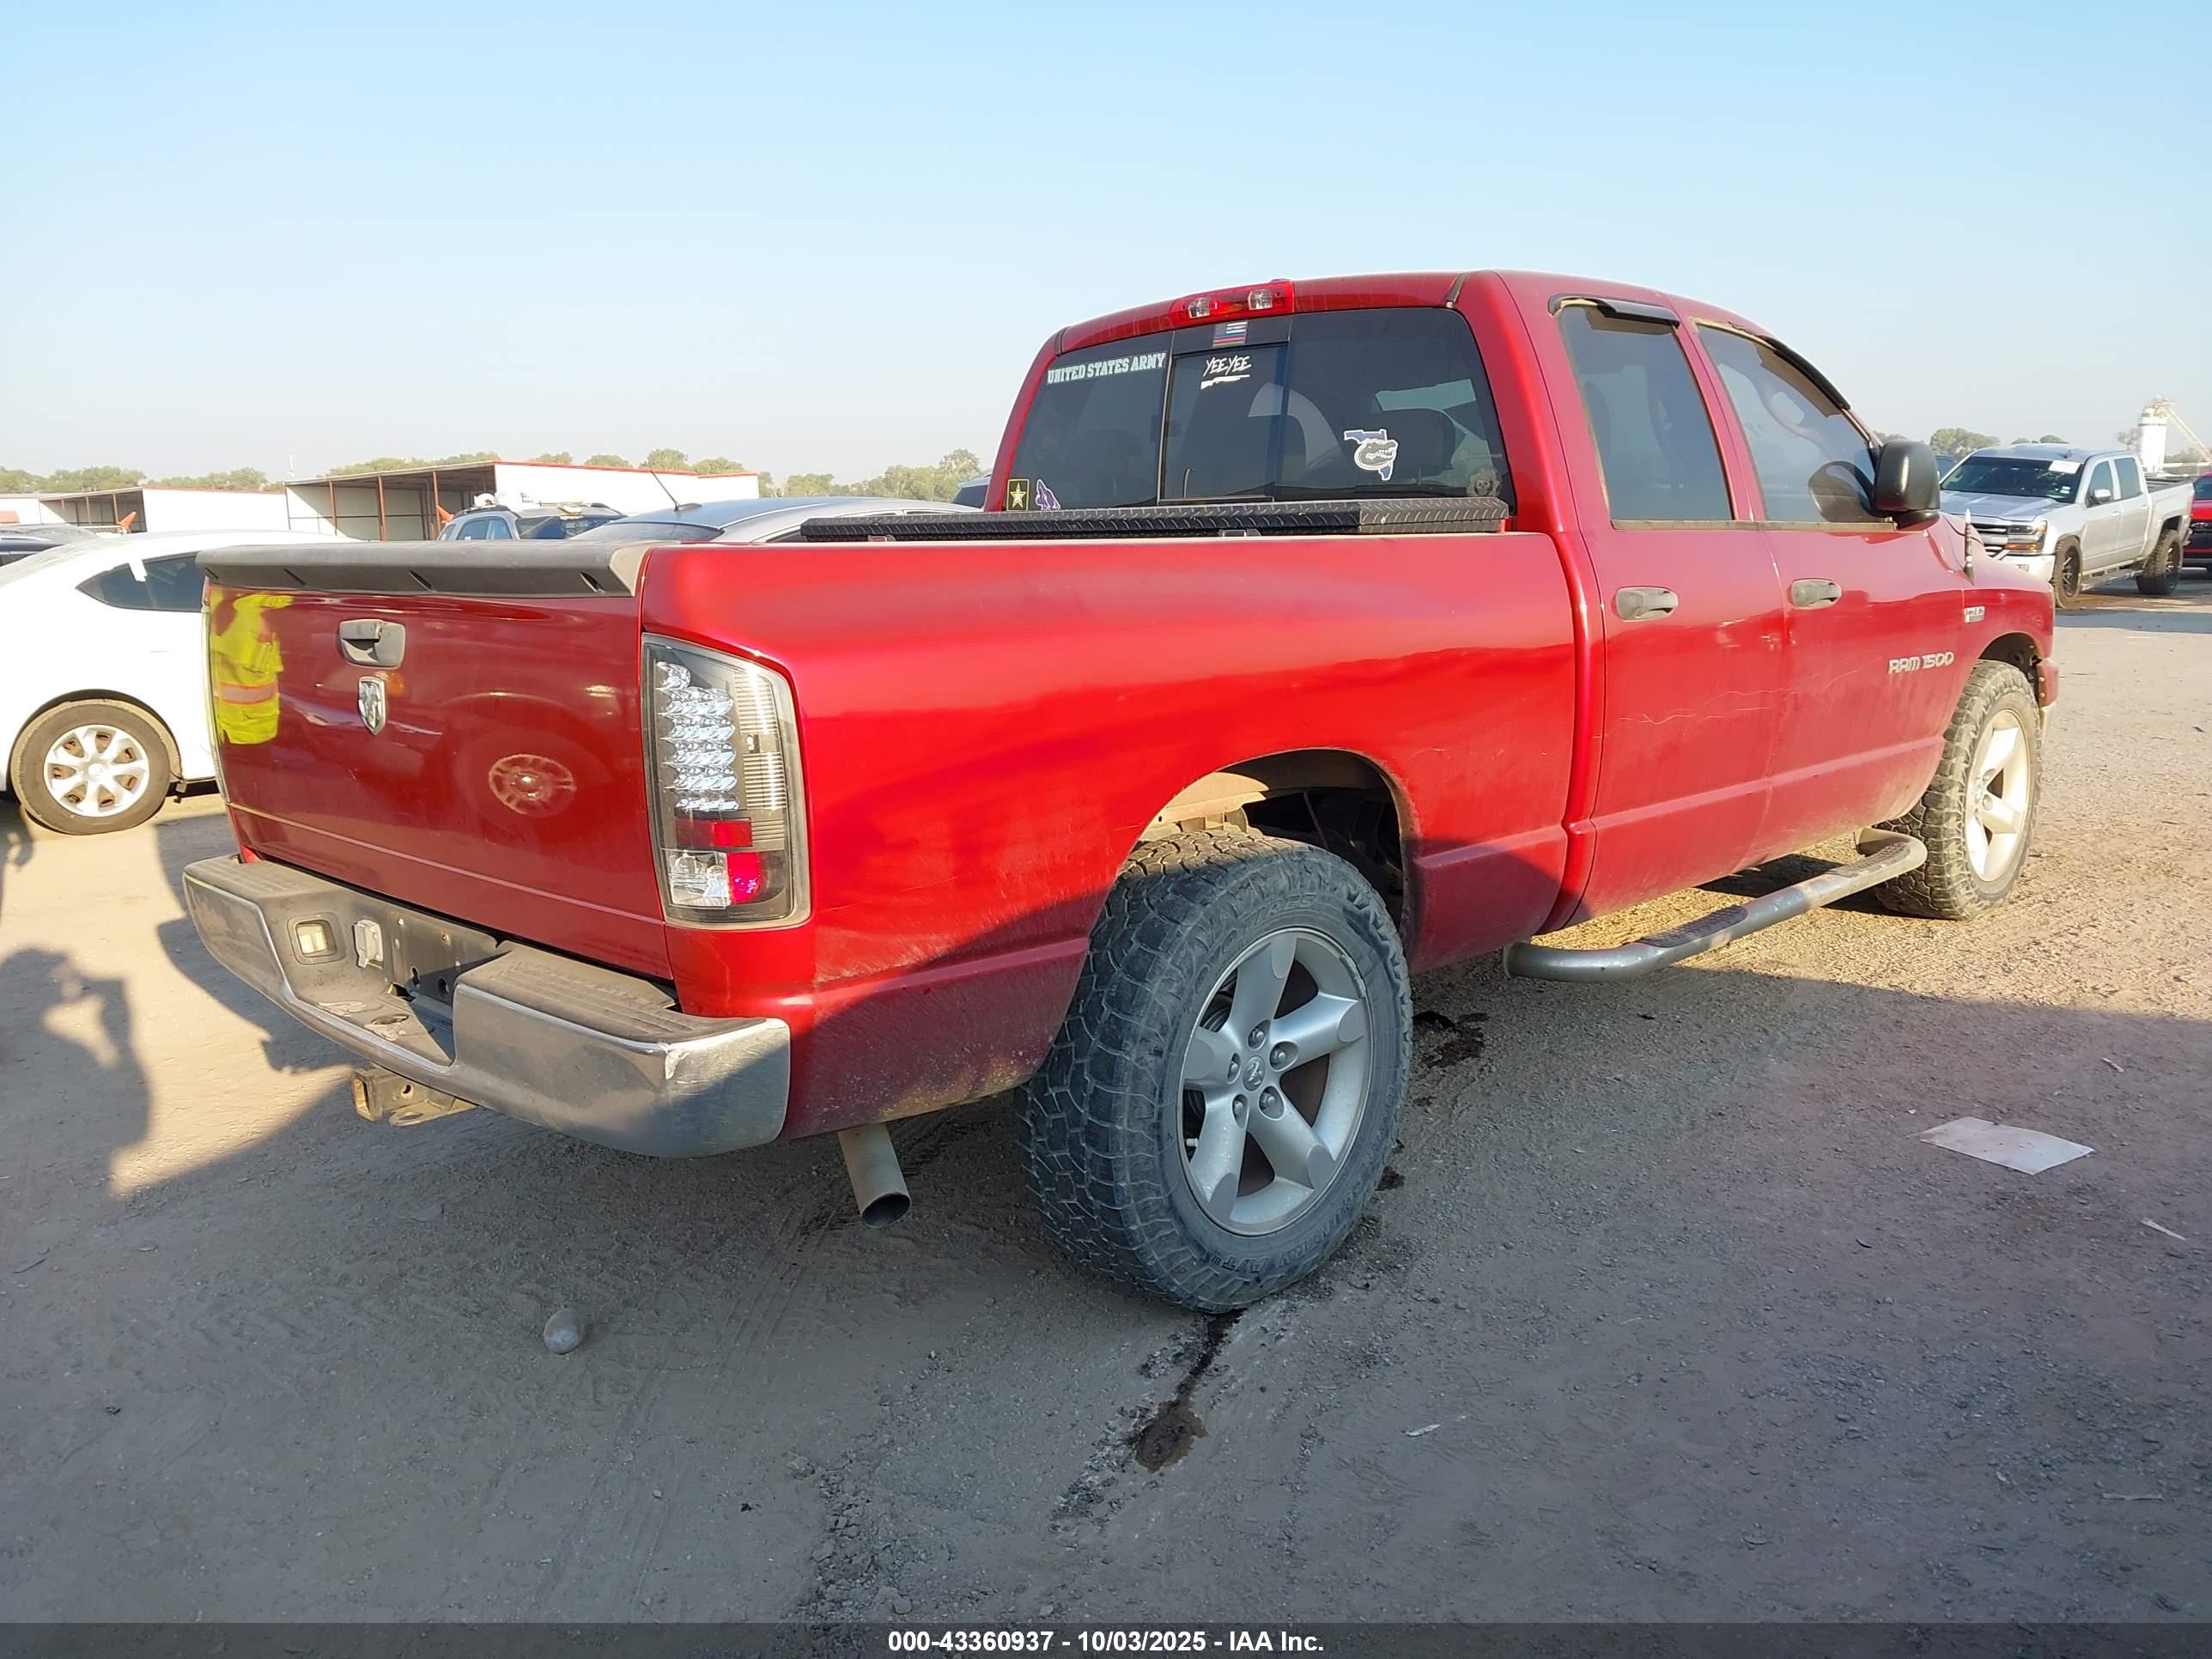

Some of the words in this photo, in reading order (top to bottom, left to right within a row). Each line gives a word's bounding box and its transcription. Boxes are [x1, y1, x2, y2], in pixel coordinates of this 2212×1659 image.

[1048, 364, 1085, 384] UNITED
[1086, 358, 1129, 378] STATES
[1130, 353, 1165, 372] ARMY
[1888, 657, 1921, 674] RAM
[1922, 652, 1955, 668] 1500
